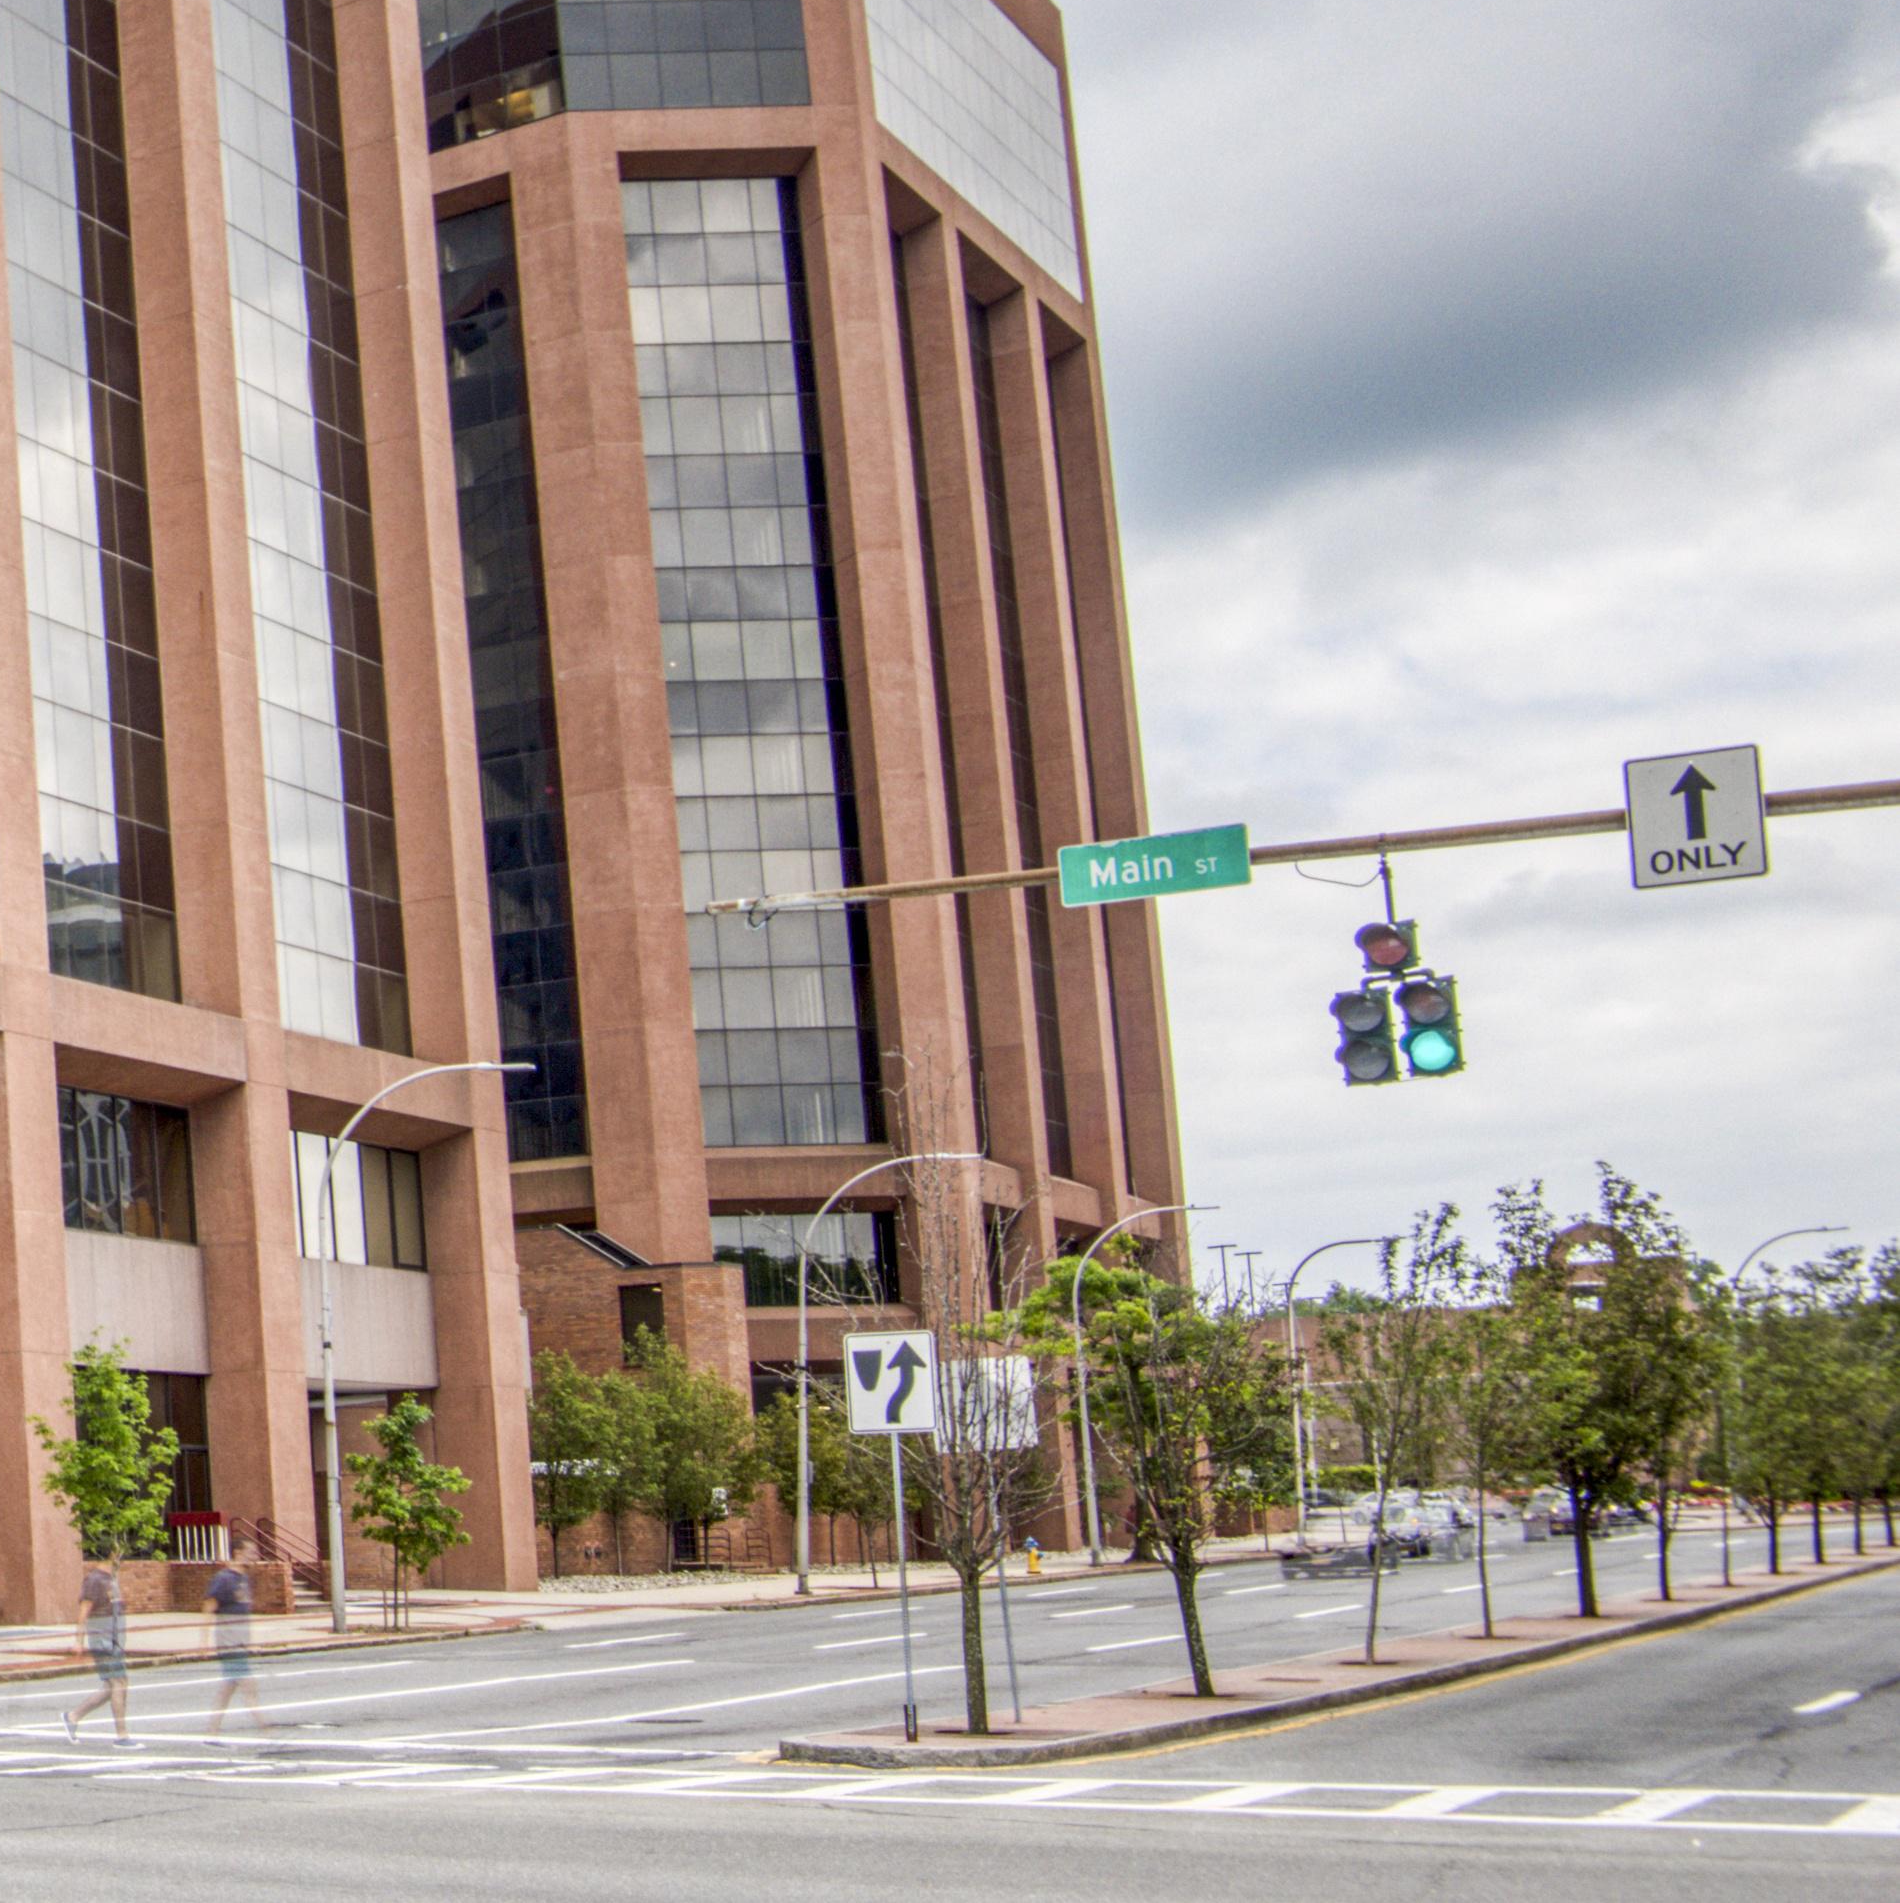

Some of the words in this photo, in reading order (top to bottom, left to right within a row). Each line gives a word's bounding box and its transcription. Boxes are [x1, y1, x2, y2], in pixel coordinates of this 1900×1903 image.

[1090, 853, 1174, 888] Main
[1195, 856, 1218, 877] ST
[1650, 841, 1747, 875] ONLY
